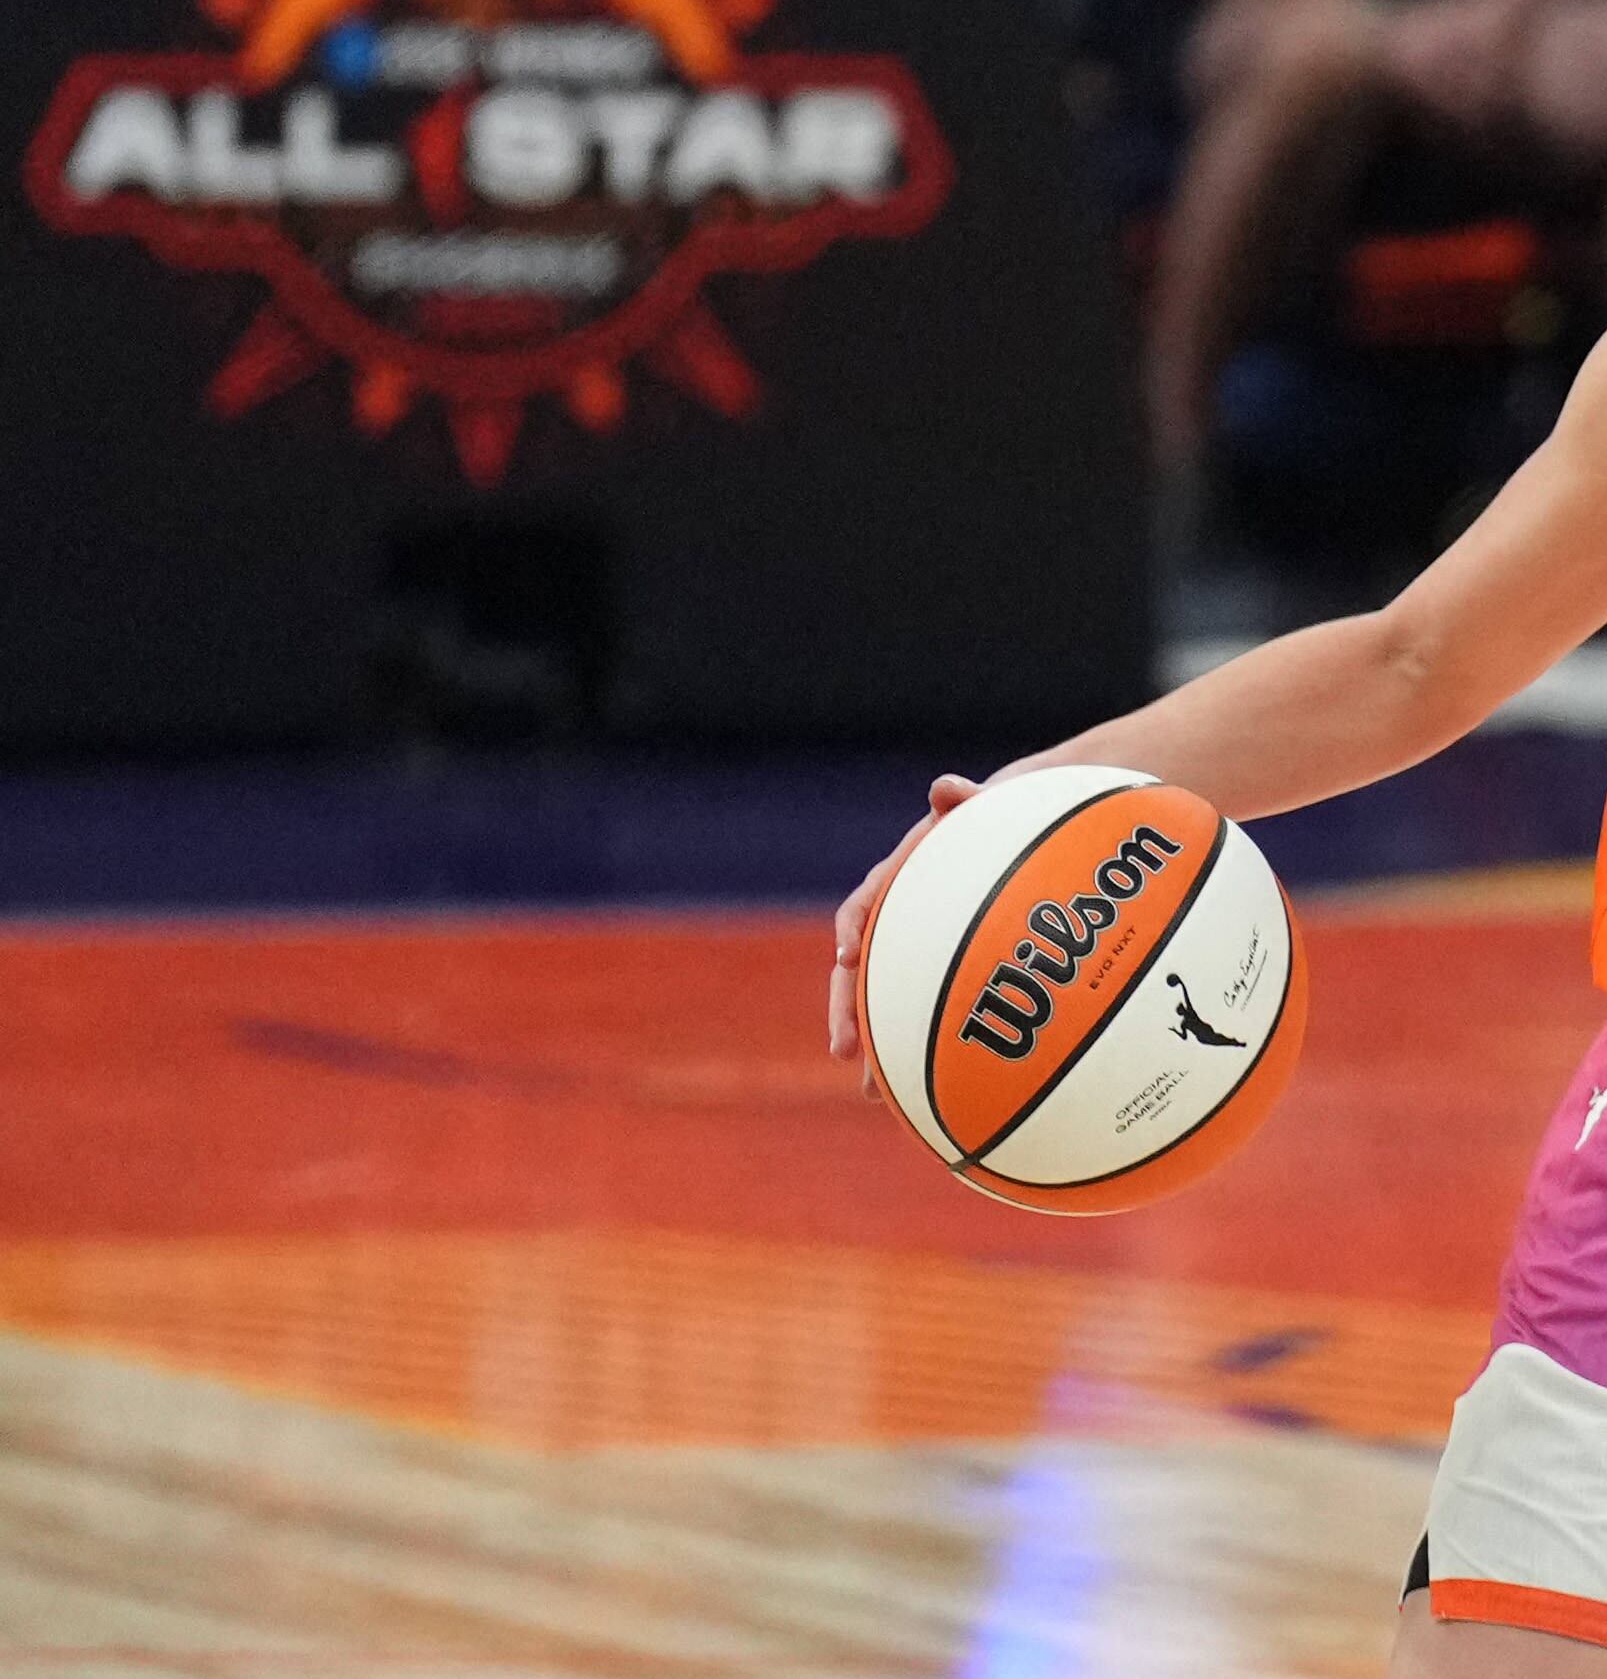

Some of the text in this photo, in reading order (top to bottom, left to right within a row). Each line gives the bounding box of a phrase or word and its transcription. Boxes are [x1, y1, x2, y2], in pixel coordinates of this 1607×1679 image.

[64, 84, 402, 204] ALL
[958, 824, 1184, 1063] Wilson
[1115, 1070, 1174, 1120] OFFICIAL
[1115, 1101, 1155, 1134] GAME
[1156, 1069, 1189, 1100] BALL
